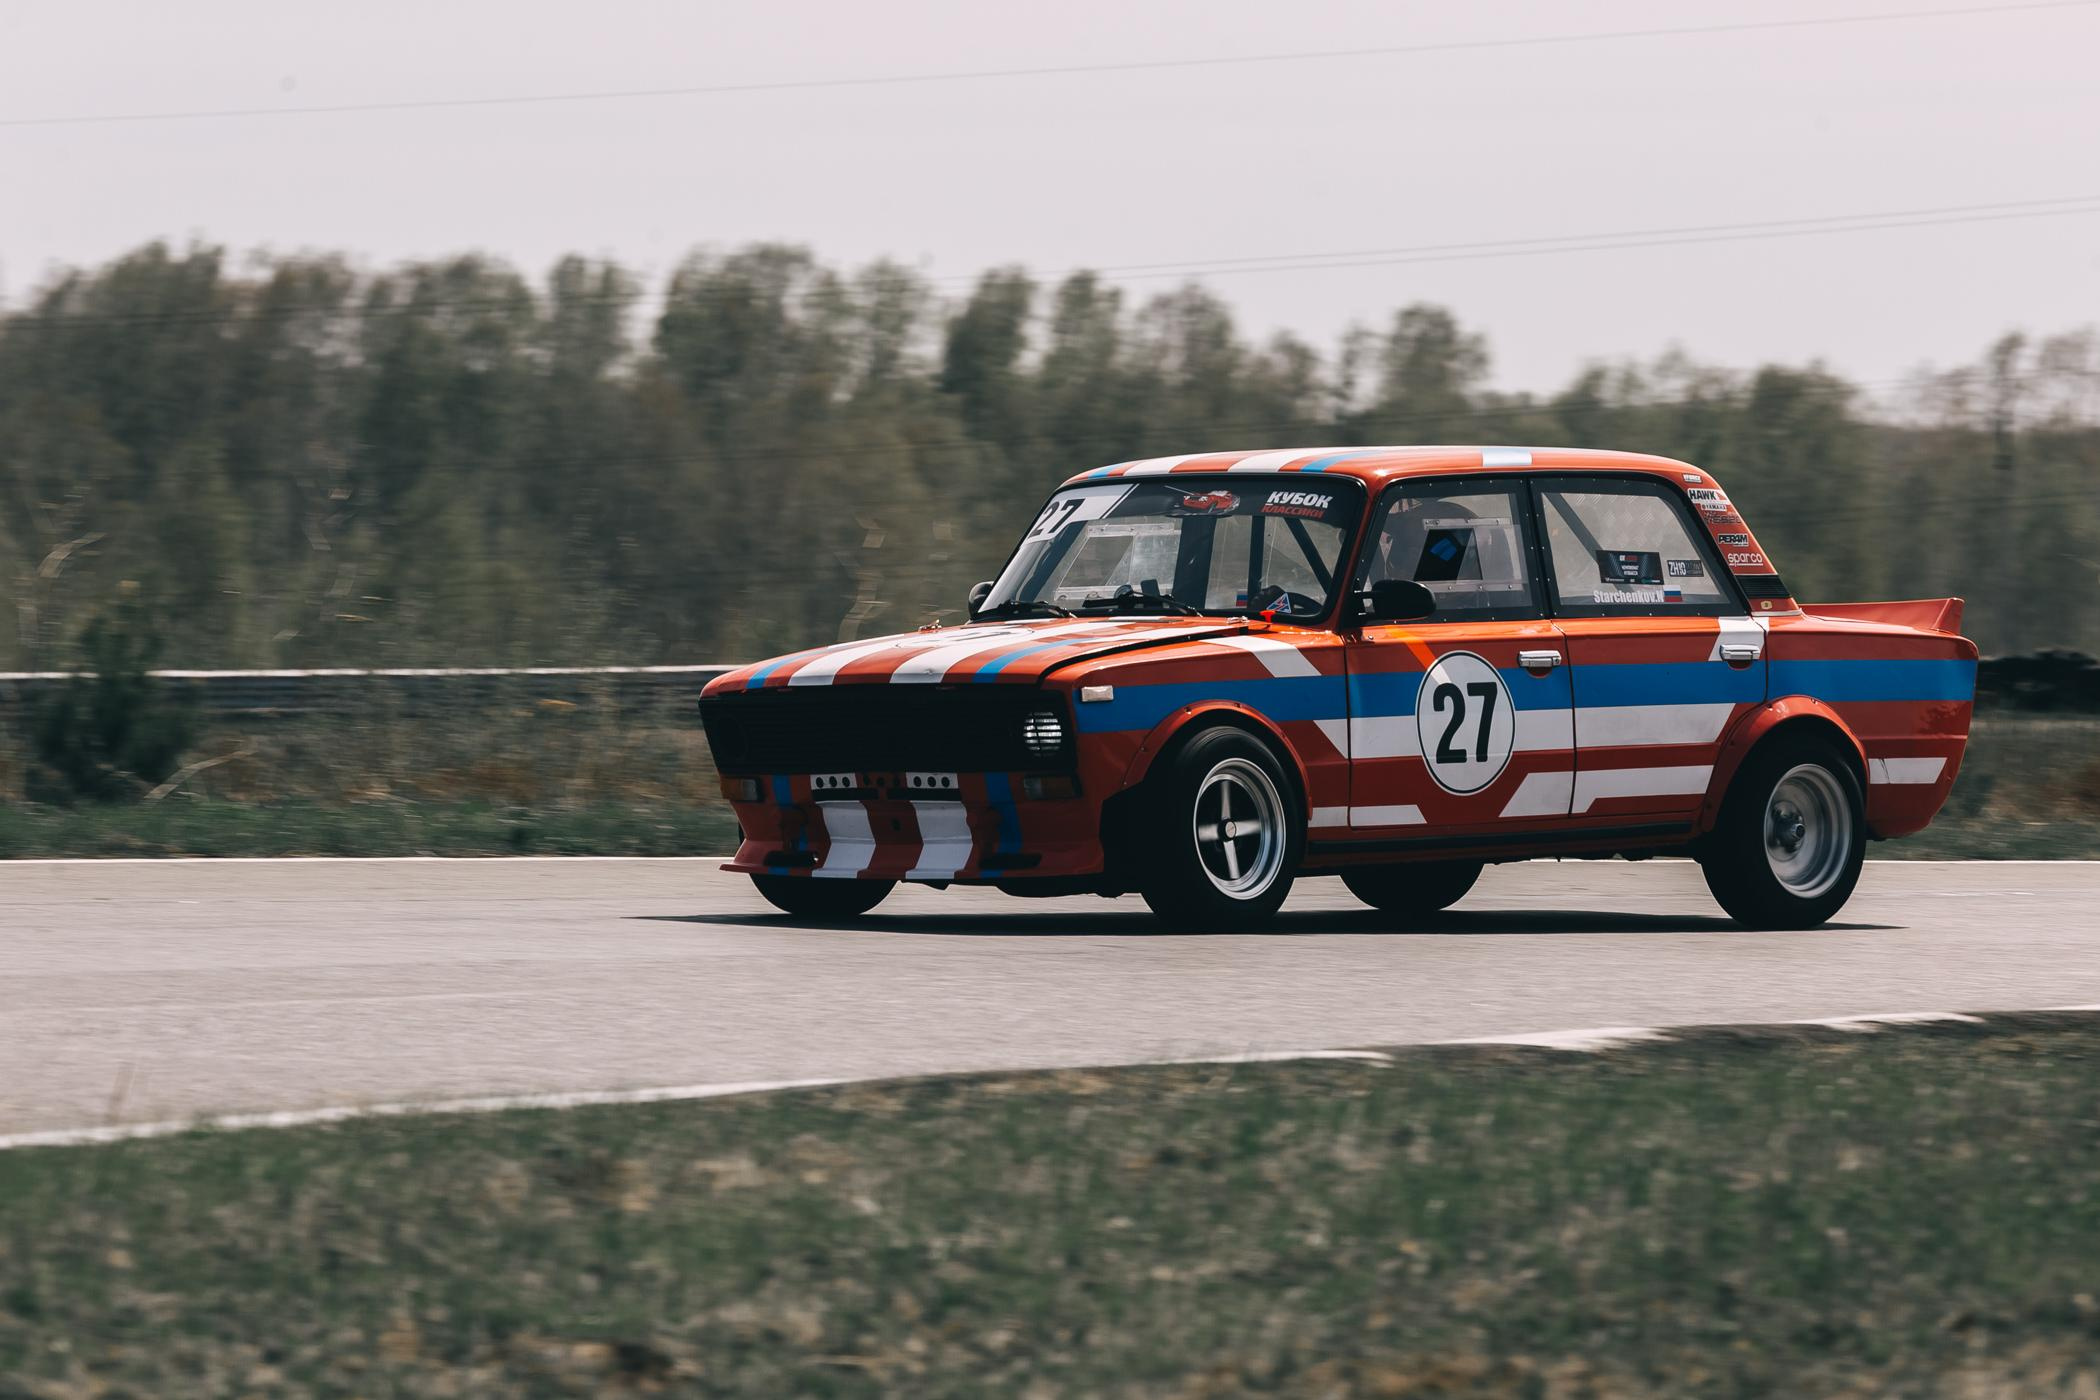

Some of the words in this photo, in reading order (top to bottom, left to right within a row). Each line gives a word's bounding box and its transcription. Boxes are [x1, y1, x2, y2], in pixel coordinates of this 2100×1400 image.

[1267, 491, 1333, 509] КУБОК
[1689, 490, 1717, 501] HAWK
[1028, 498, 1086, 539] 27
[1728, 553, 1763, 567] sparco
[1433, 682, 1498, 765] 27
